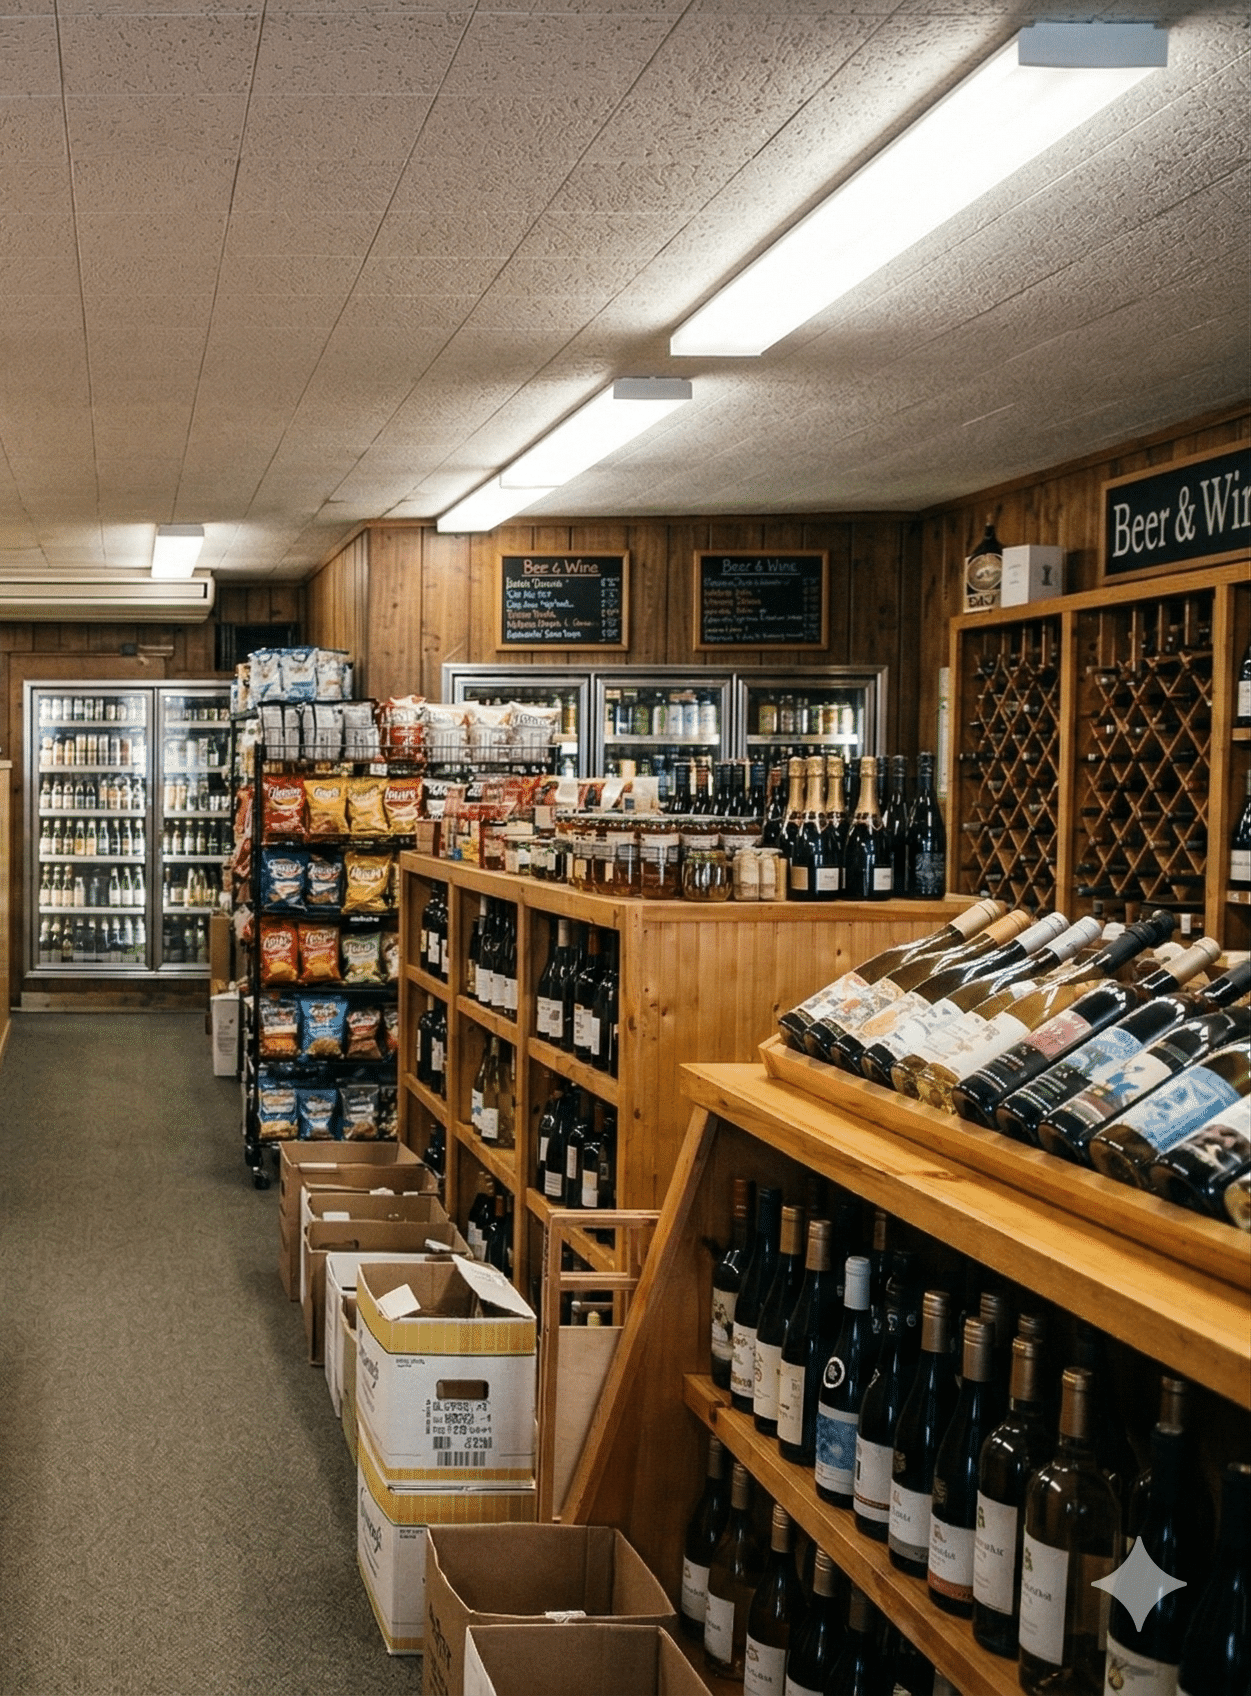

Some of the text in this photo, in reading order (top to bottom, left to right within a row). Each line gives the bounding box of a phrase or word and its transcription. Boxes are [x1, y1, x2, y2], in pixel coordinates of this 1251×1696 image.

[1112, 503, 1170, 558] Beer
[1175, 485, 1196, 543] &
[564, 559, 599, 573] Wine
[722, 558, 752, 573] Beer
[767, 559, 798, 572] Wine
